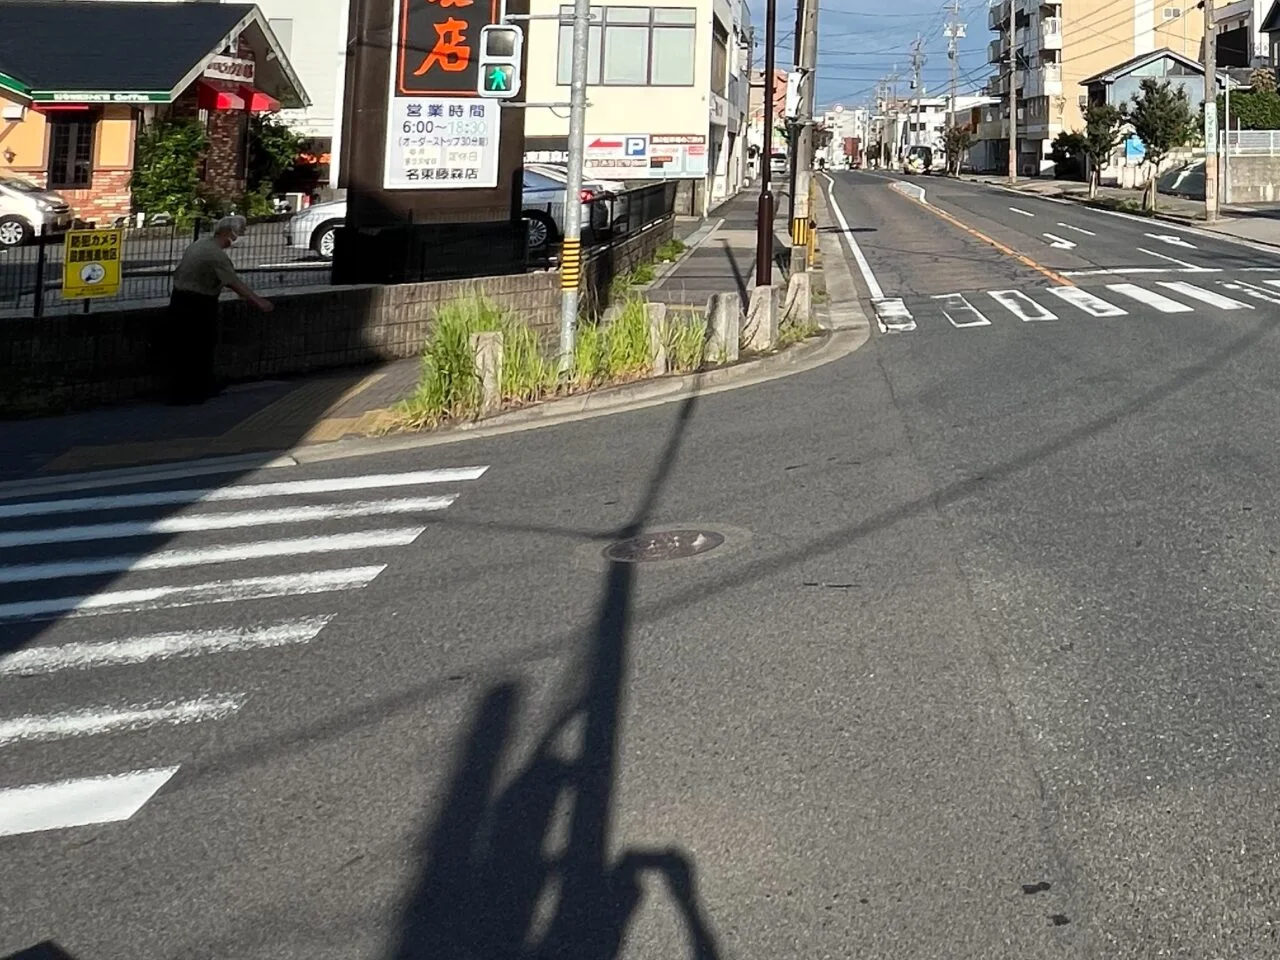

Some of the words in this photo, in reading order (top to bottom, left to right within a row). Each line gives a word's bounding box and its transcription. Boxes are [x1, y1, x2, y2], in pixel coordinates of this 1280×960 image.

[406, 103, 485, 118] 営業時間
[627, 139, 644, 156] P
